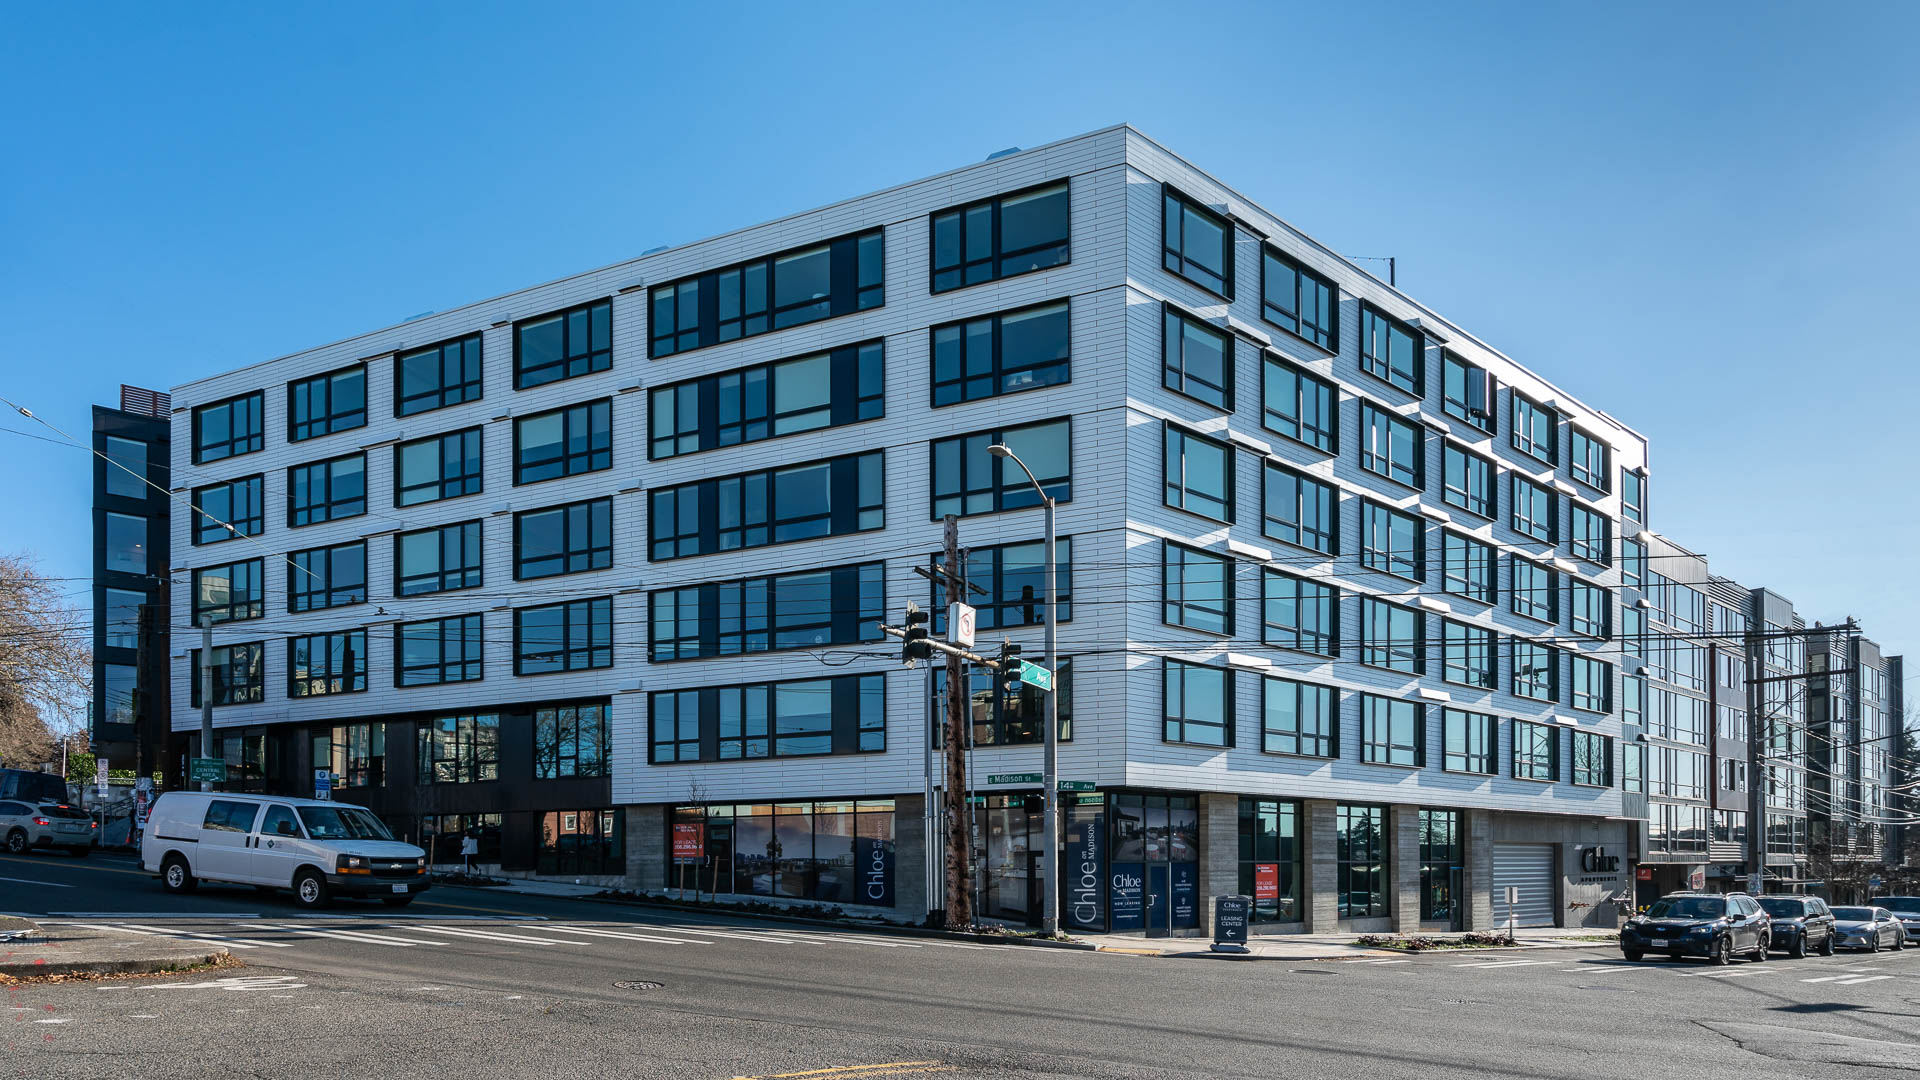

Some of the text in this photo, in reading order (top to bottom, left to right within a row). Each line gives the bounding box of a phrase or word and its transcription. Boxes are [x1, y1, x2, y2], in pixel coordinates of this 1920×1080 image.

[994, 774, 1023, 783] Madison
[1081, 850, 1087, 860] on
[1581, 846, 1619, 873] Chloe
[867, 850, 885, 899] Chloe
[1113, 873, 1142, 888] Chloe
[1074, 861, 1097, 923] Chloe
